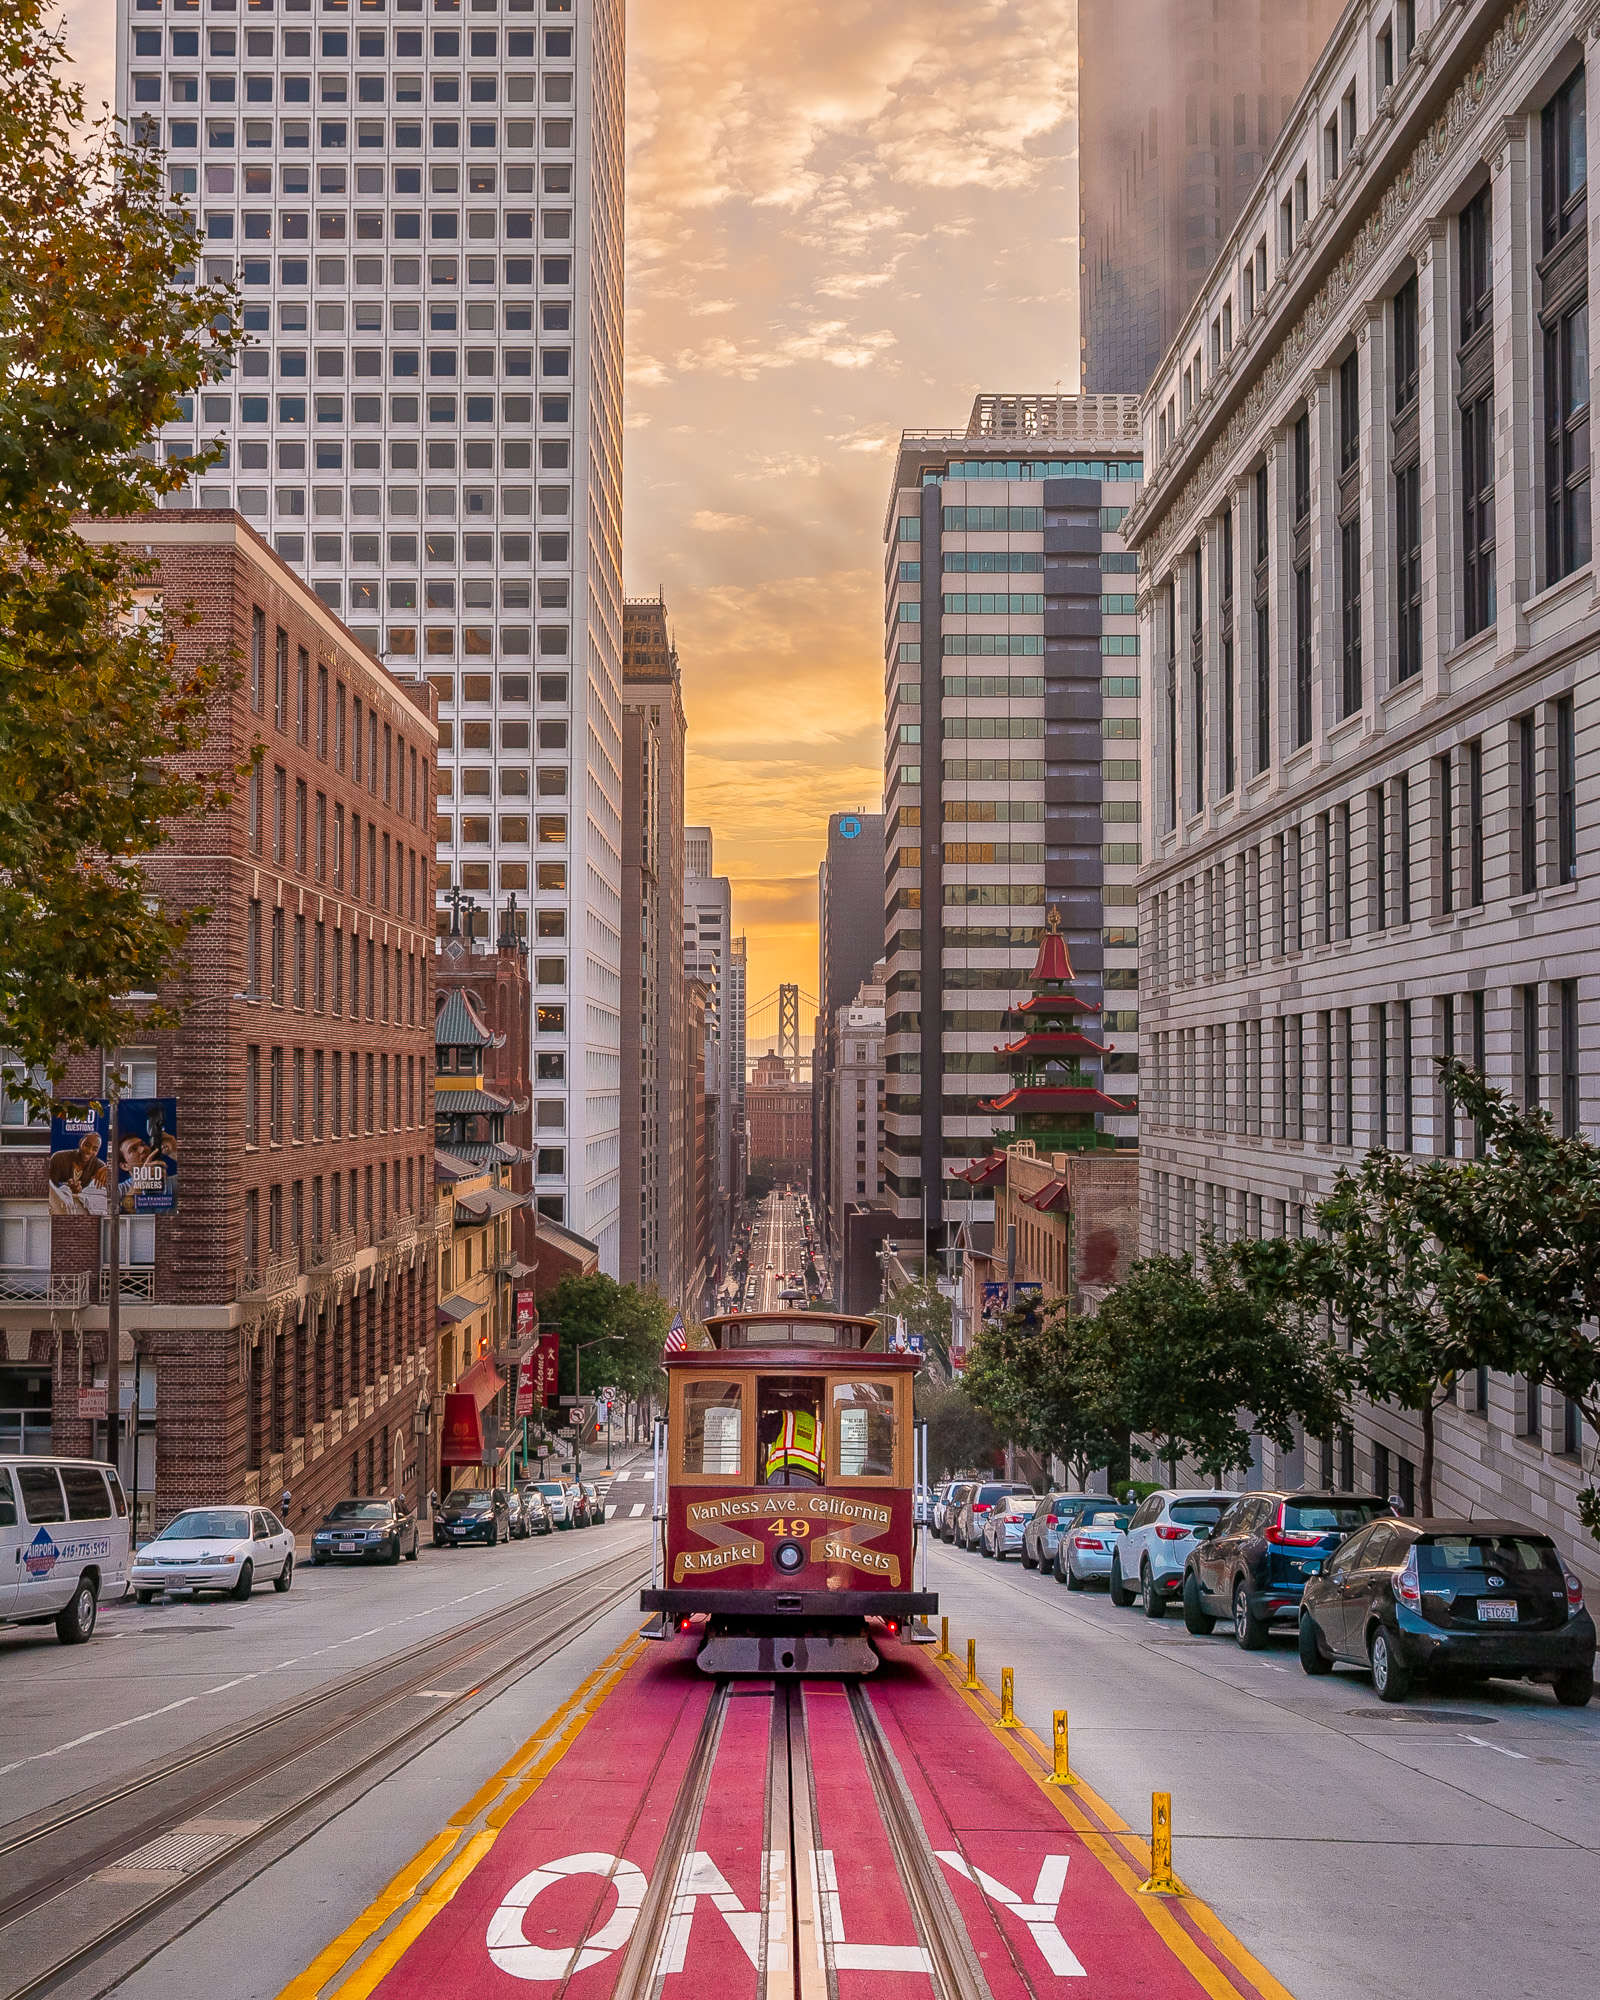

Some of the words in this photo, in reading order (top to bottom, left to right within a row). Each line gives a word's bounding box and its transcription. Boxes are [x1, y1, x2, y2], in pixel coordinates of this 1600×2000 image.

[65, 1123, 95, 1132] QUESTIONS
[133, 1166, 162, 1181] BOLD
[133, 1181, 163, 1190] ANSWERS
[534, 1353, 545, 1403] Welcome
[79, 1389, 87, 1398] NO
[691, 1505, 719, 1521] Van
[720, 1501, 759, 1516] Ness
[809, 1497, 888, 1523] California
[767, 1518, 810, 1538] 49
[27, 1542, 56, 1558] AIRPORT
[684, 1554, 696, 1568] &
[699, 1544, 756, 1568] Market
[825, 1541, 890, 1569] Streets
[1481, 1607, 1516, 1618] 7ETC657
[486, 1849, 1089, 1981] ONLY
